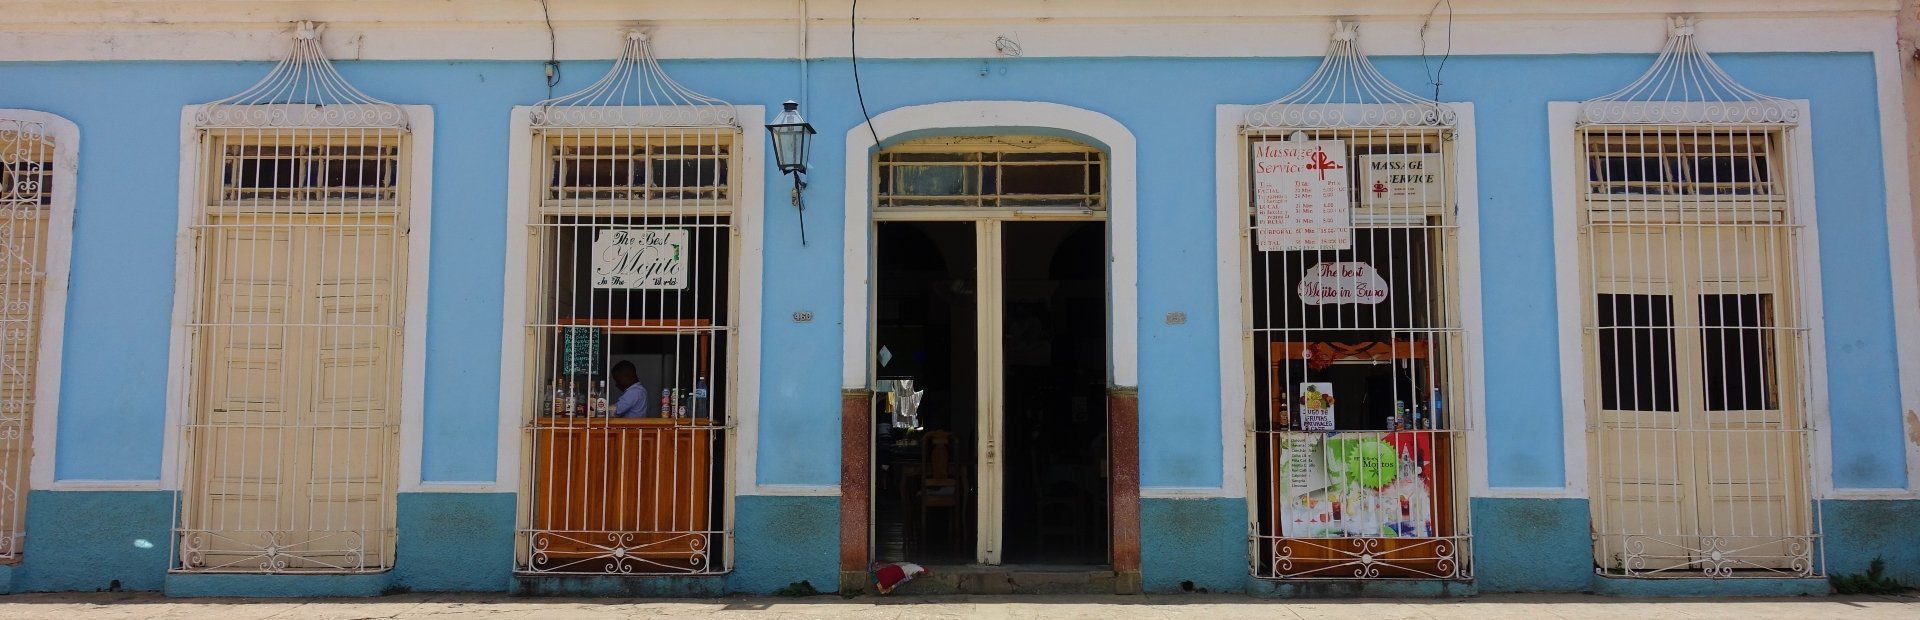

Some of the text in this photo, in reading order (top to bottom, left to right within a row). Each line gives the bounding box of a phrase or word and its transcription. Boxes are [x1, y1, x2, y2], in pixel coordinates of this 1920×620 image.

[1371, 161, 1423, 170] MASSGE
[611, 231, 671, 246] The Best
[597, 246, 679, 288] Mojito
[1317, 262, 1337, 277] The
[611, 276, 628, 286] The
[652, 277, 678, 286] Wrld
[1340, 287, 1351, 297] in
[1362, 460, 1394, 470] Mojtos
